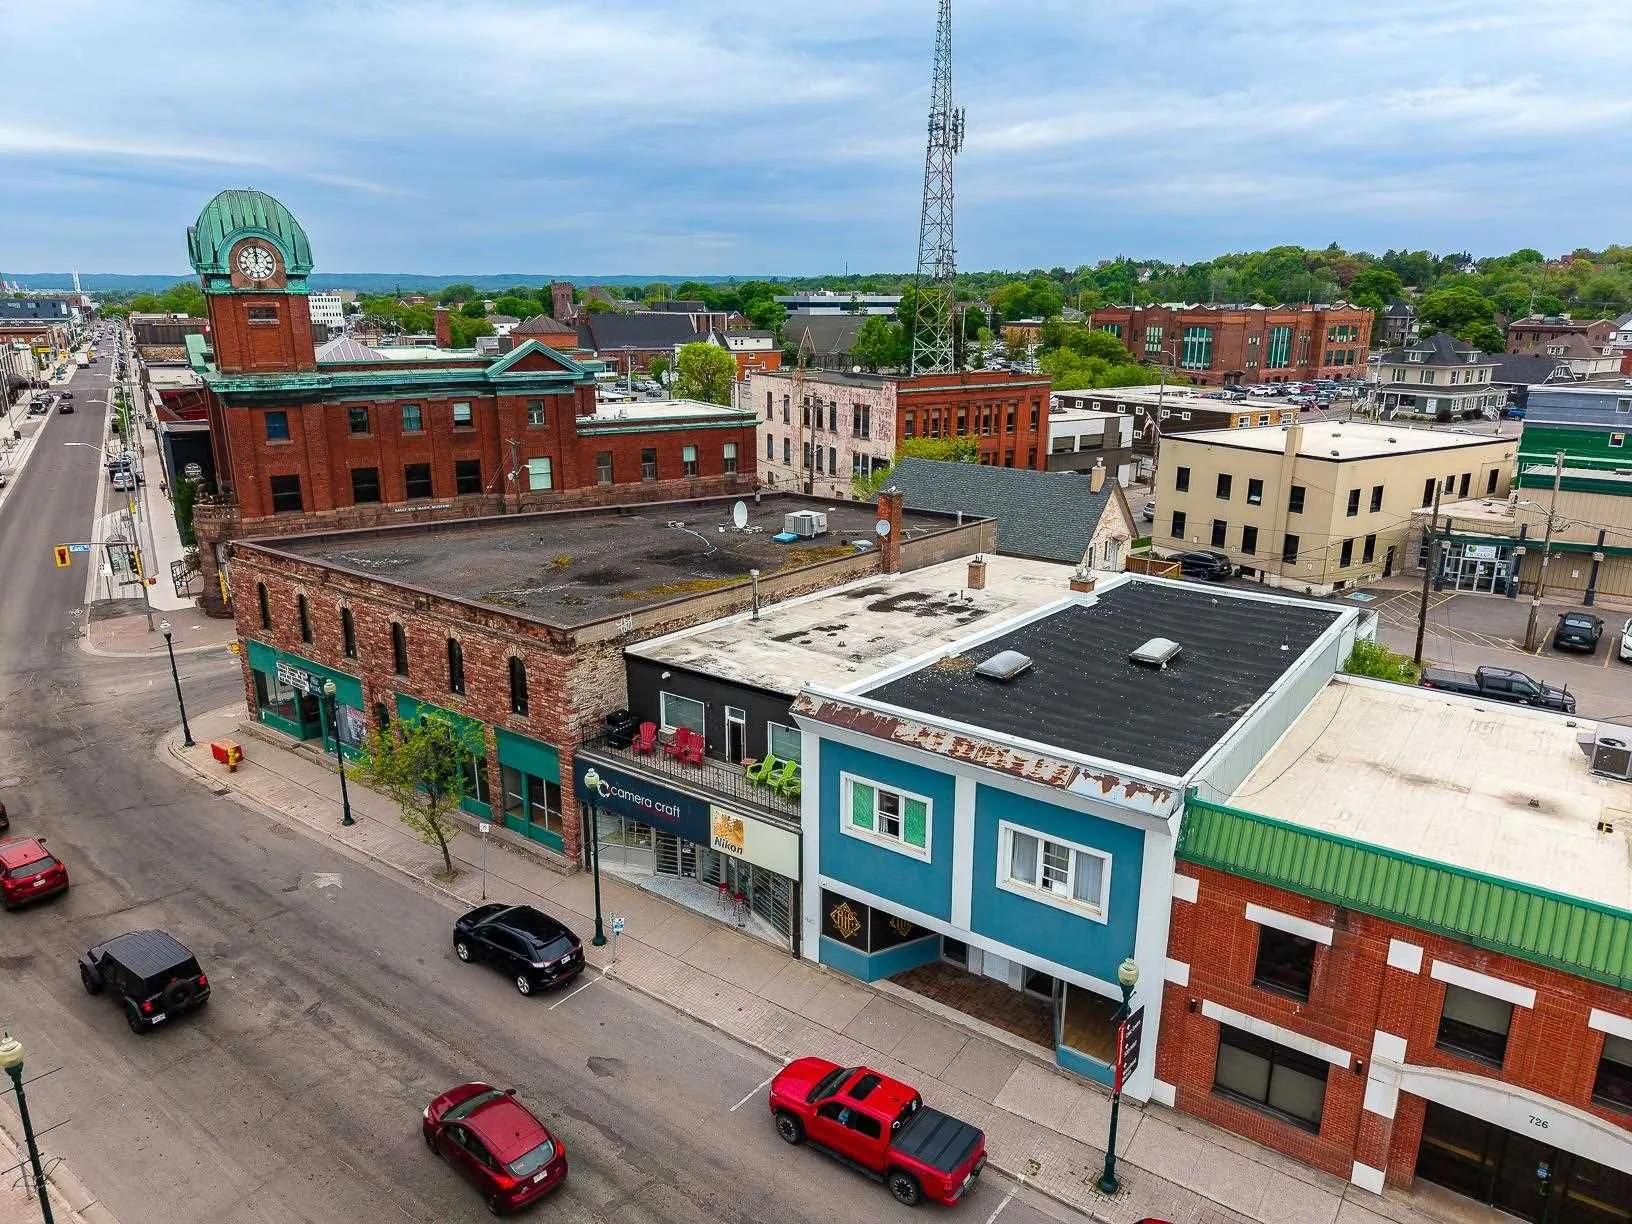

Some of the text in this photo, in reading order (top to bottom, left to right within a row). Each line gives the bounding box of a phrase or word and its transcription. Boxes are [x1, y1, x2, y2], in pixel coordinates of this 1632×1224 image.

[610, 786, 681, 818] camera craft
[714, 836, 743, 855] Nikon
[1529, 1114, 1549, 1129] 726
